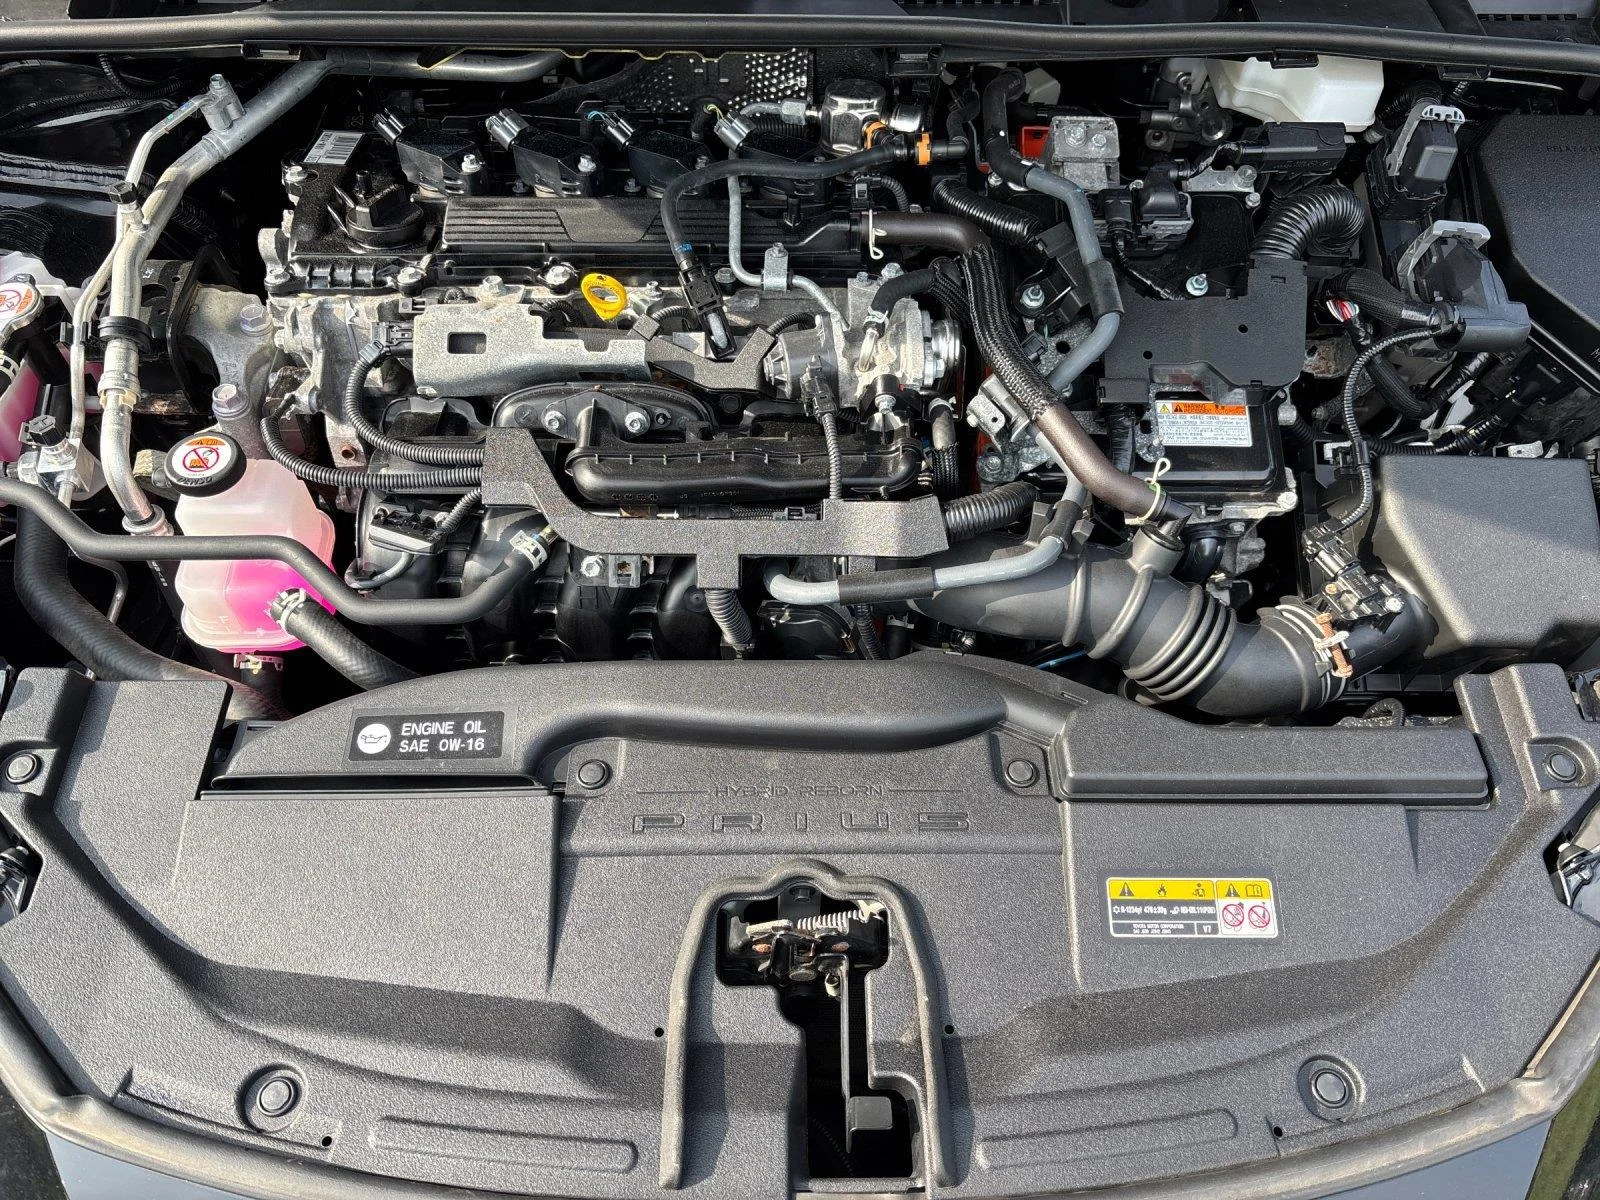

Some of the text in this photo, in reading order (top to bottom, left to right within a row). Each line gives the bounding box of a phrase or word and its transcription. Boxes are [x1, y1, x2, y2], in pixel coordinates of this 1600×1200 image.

[400, 720, 486, 736] ENGINE OIL
[399, 738, 485, 752] SAE 0W-16
[715, 784, 884, 798] HYBRID REBORN
[632, 811, 970, 833] PRIUS
